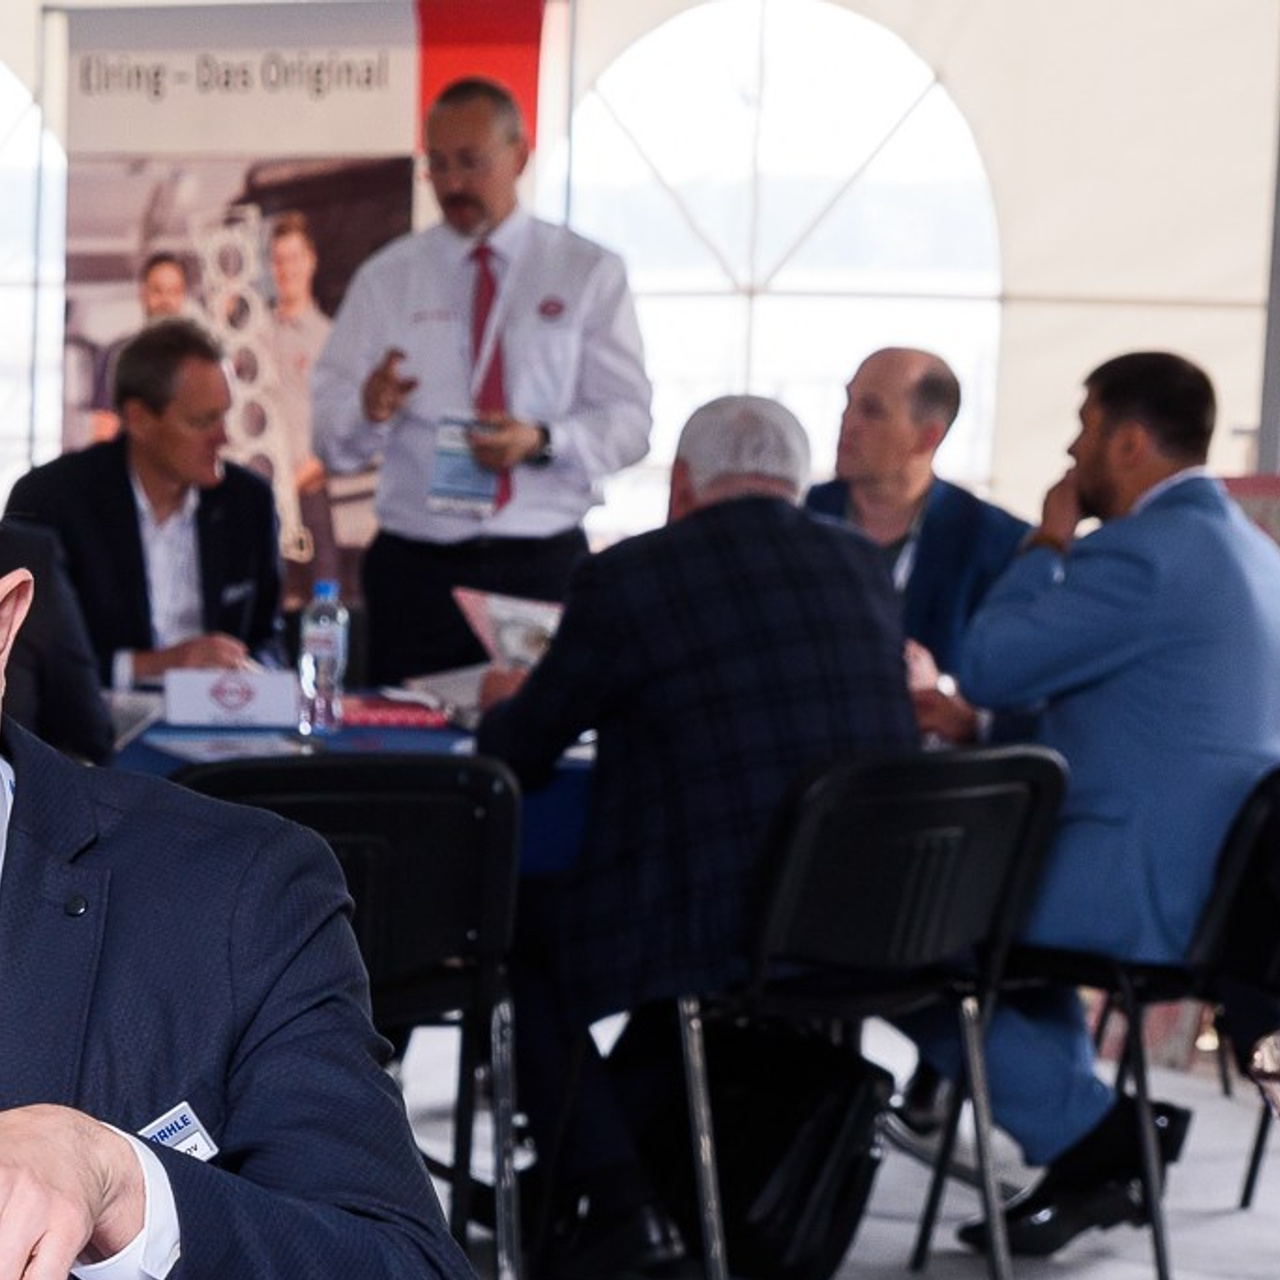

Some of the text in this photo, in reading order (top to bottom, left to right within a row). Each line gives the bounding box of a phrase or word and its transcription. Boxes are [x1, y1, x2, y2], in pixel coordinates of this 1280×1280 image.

[79, 54, 166, 102] Elring
[196, 54, 254, 92] Das
[261, 51, 389, 102] Original
